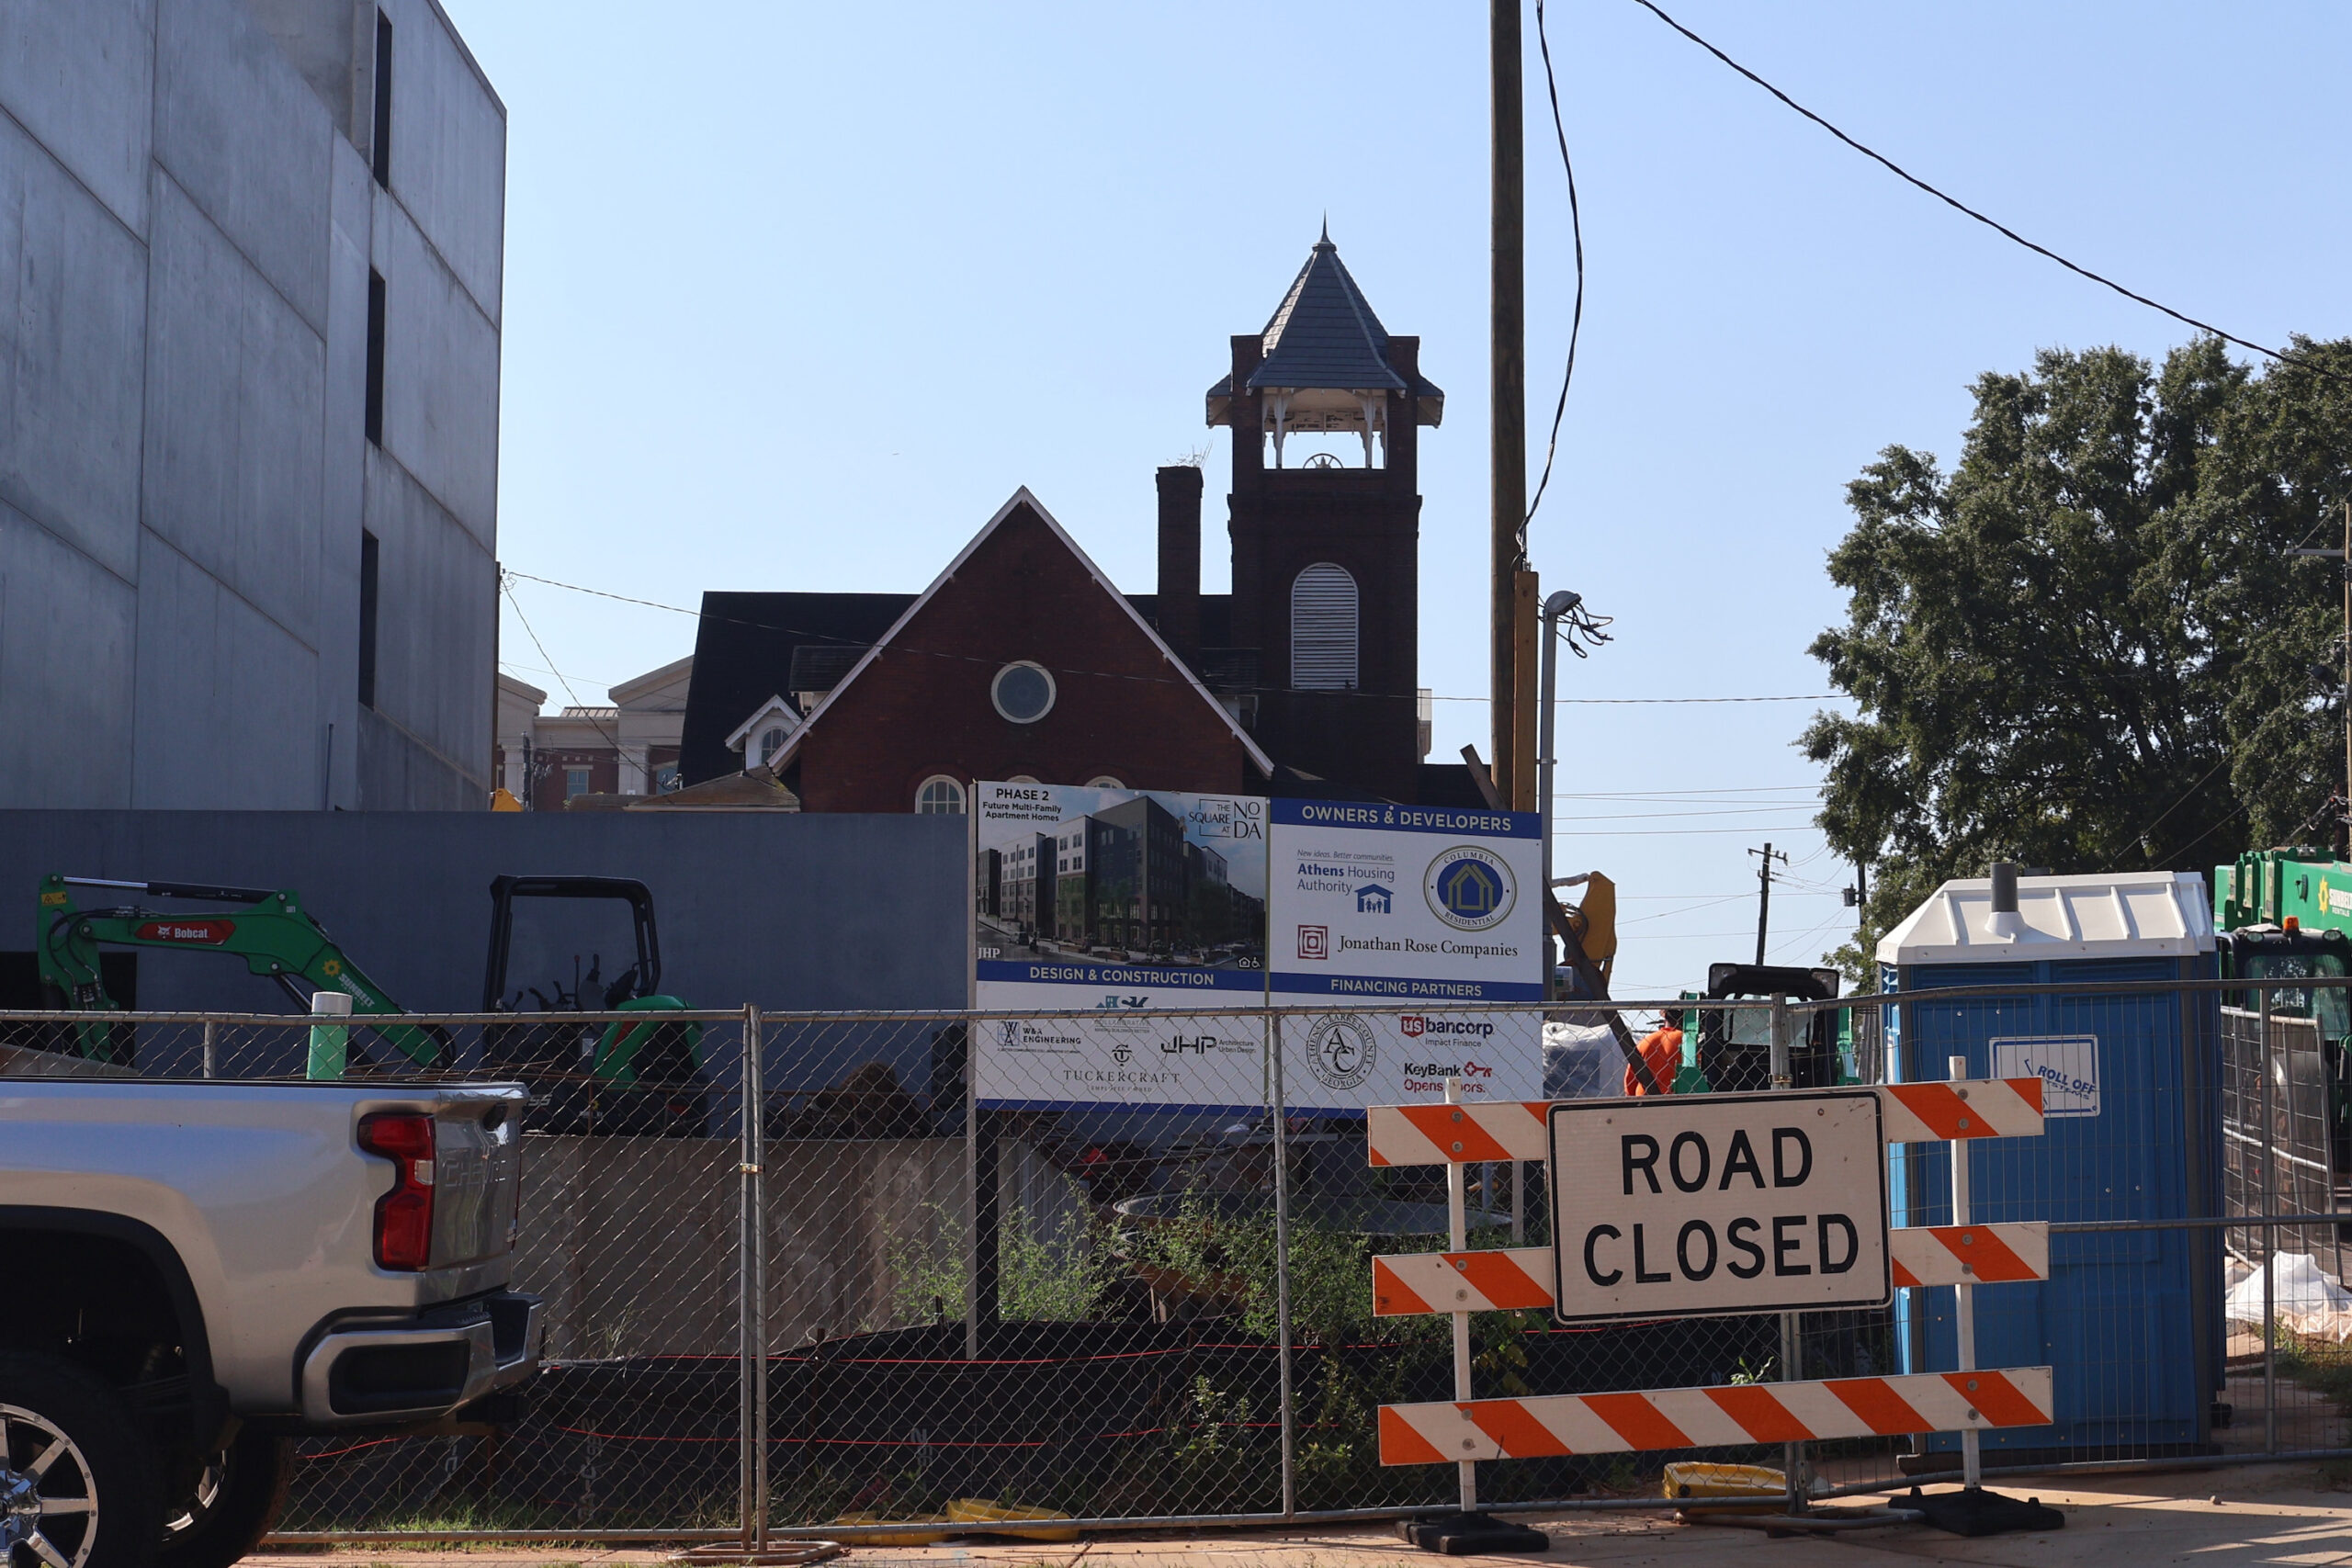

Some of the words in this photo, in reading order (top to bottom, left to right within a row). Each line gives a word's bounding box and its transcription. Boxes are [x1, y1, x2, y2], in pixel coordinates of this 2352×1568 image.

[996, 788, 1038, 800] PHASE
[1042, 791, 1049, 801] 2
[982, 801, 1010, 810] Future
[1012, 803, 1062, 814] Multi-Family
[1216, 804, 1230, 812] THE
[985, 810, 1030, 820] Apartment
[1031, 813, 1059, 822] Homes
[1189, 811, 1230, 824] SQUARE
[1302, 806, 1378, 824] OWNERS
[1384, 809, 1395, 825] &
[1400, 811, 1511, 831] DEVELOPERS
[1234, 820, 1261, 840] DA
[1297, 849, 1312, 857] New
[1313, 850, 1331, 858] ideas.
[1333, 851, 1352, 860] Better
[1353, 852, 1395, 862] communities.
[1443, 852, 1495, 865] COLUMBIA
[1297, 863, 1344, 876] Athens
[1348, 865, 1395, 883] Housing
[1297, 878, 1352, 896] Authority
[1444, 911, 1495, 925] RESIDENTIAL
[175, 927, 209, 939] Bobcat
[978, 947, 1001, 960] JHP
[1338, 935, 1401, 952] Jonathan
[1404, 939, 1437, 953] Rose
[1441, 940, 1519, 958] Companies
[1030, 966, 1084, 981] DESIGN
[1088, 968, 1098, 981] &
[1102, 970, 1215, 986] CONSTRUCTION
[338, 973, 375, 1007] SUNBELT
[1330, 979, 1408, 993] FINANCING
[1412, 982, 1482, 997] PARTNERS
[1023, 1027, 1043, 1035] W&A
[1425, 1017, 1494, 1039] bancorp
[1023, 1036, 1081, 1044] ENGINEERING
[1160, 1035, 1217, 1055] JHP
[1425, 1038, 1452, 1046] Impact
[1453, 1038, 1482, 1047] Finance
[1064, 1070, 1181, 1083] TUCKERCRAFT
[1404, 1063, 1462, 1077] KeyBank
[1322, 1074, 1363, 1088] GEORGIA
[1404, 1078, 1443, 1094] Opens
[1460, 1082, 1486, 1093] ors.
[2037, 1065, 2068, 1086] ROLL
[2072, 1079, 2096, 1095] OFF
[1620, 1127, 1813, 1195] ROAD
[1583, 1213, 1859, 1287] CLOSED
